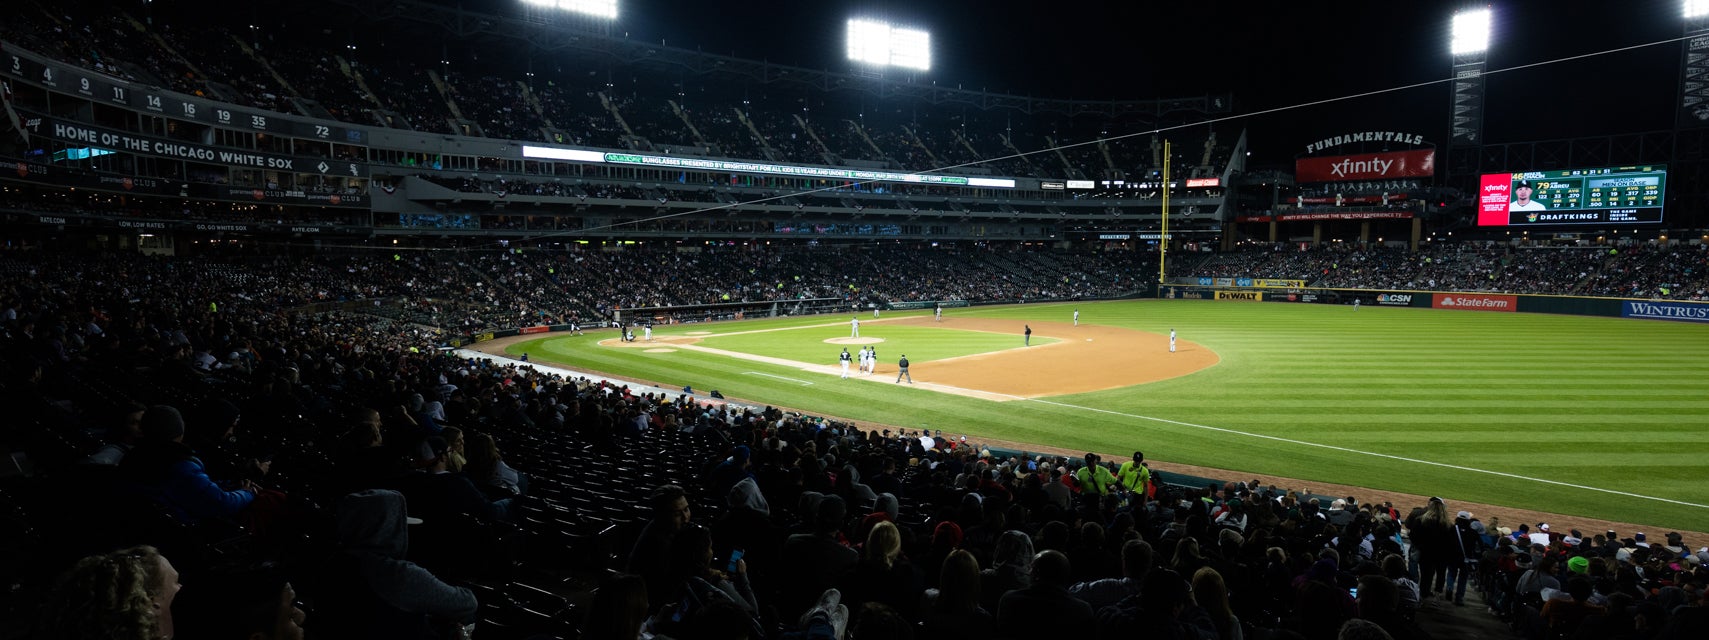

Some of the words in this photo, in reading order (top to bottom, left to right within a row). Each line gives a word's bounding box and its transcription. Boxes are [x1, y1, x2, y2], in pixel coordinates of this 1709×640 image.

[12, 55, 21, 70] 3
[43, 67, 52, 81] 4
[81, 77, 90, 90] 9
[113, 86, 124, 99] 11
[147, 95, 161, 107] 14
[182, 102, 196, 114] 16
[217, 109, 231, 121] 19
[251, 115, 266, 126] 35
[315, 125, 330, 136] 72
[55, 124, 97, 143] HOME
[101, 132, 119, 146] OF
[122, 136, 150, 152] THE
[154, 142, 215, 160] CHICAGO
[219, 151, 264, 166] WHITE
[268, 158, 293, 170] SOX
[1306, 131, 1423, 154] FUNDAMENTALS
[642, 157, 680, 165] SUNGLASSES
[681, 159, 714, 168] PRESENTED
[1331, 157, 1393, 178] xfinity
[28, 165, 48, 174] CLUB
[1484, 184, 1508, 192] xfinity
[40, 216, 65, 224] RATE.COM
[1390, 294, 1412, 302] CSN
[1455, 297, 1481, 307] State
[1481, 298, 1508, 308] Farm
[1630, 302, 1709, 318] WINTRUS
